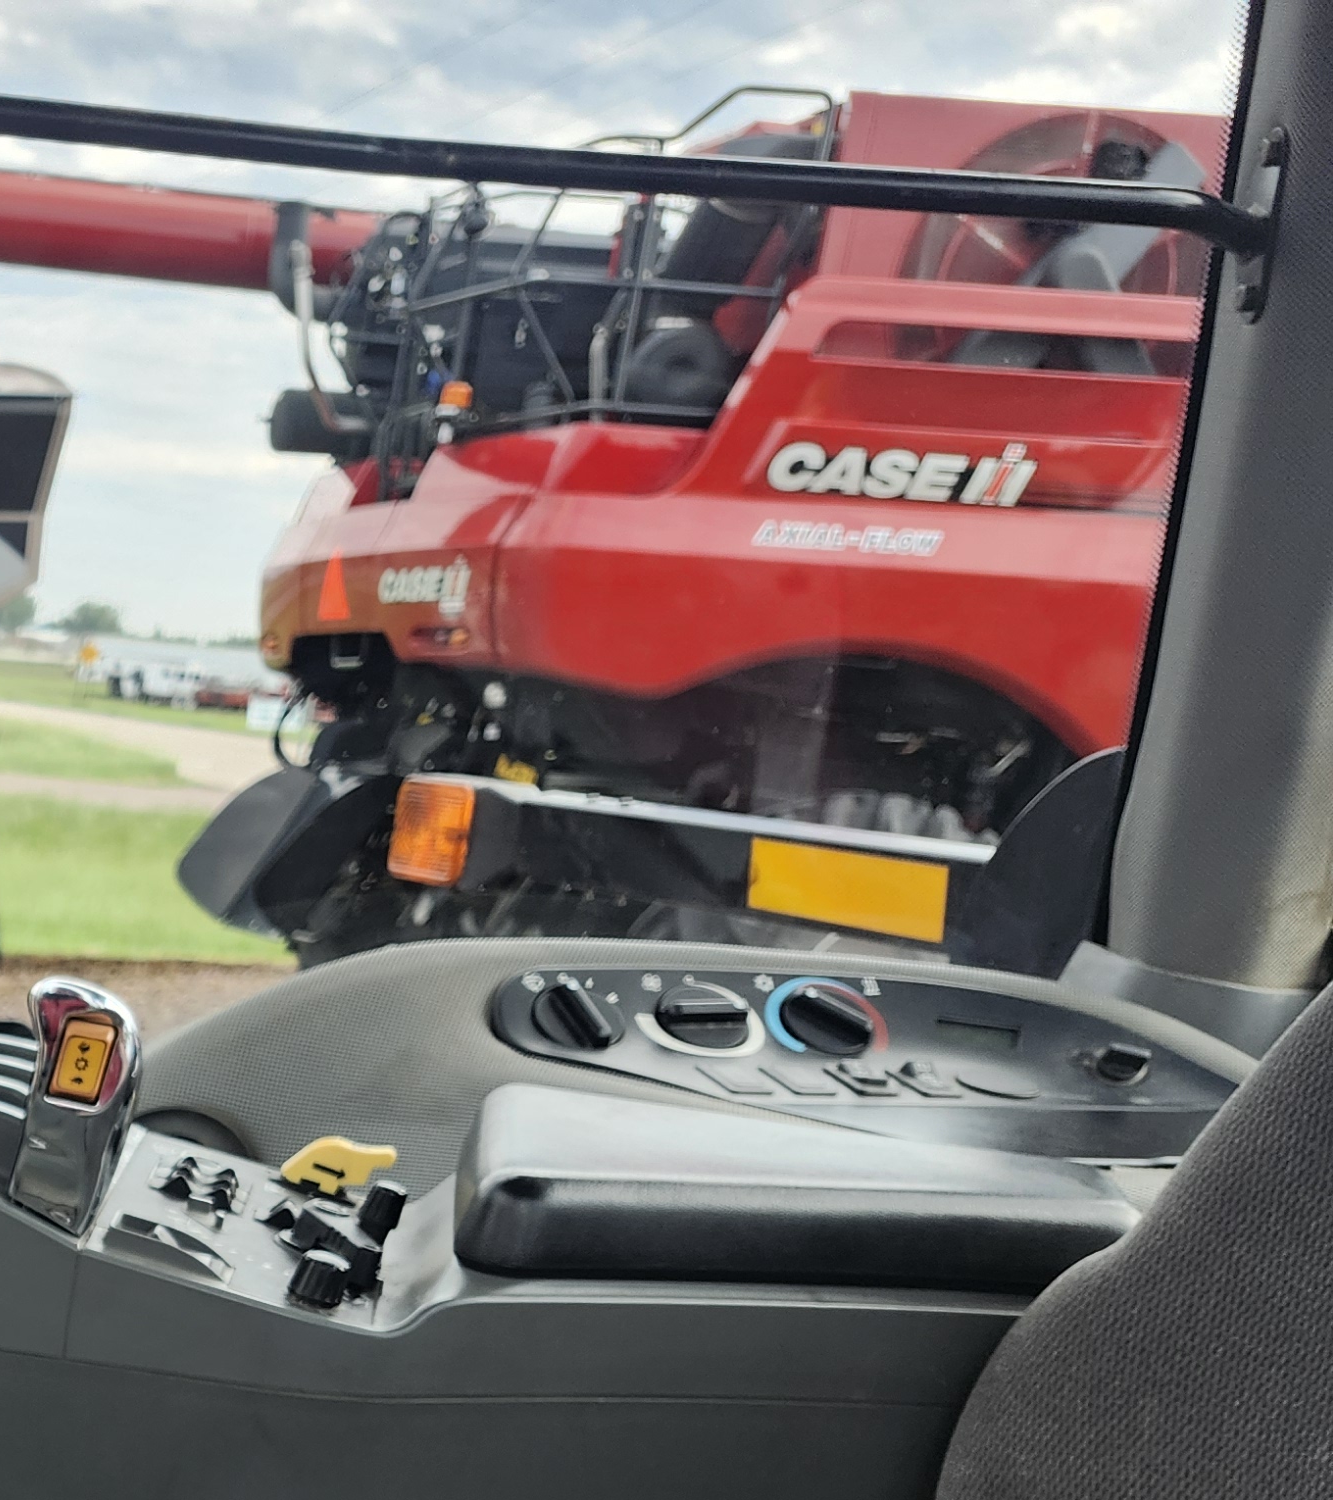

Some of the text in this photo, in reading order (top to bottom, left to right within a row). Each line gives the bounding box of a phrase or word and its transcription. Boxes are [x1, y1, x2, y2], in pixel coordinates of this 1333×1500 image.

[767, 441, 970, 502] CASE
[751, 519, 945, 557] AXIAL-FLOW
[377, 566, 443, 604] CASE
